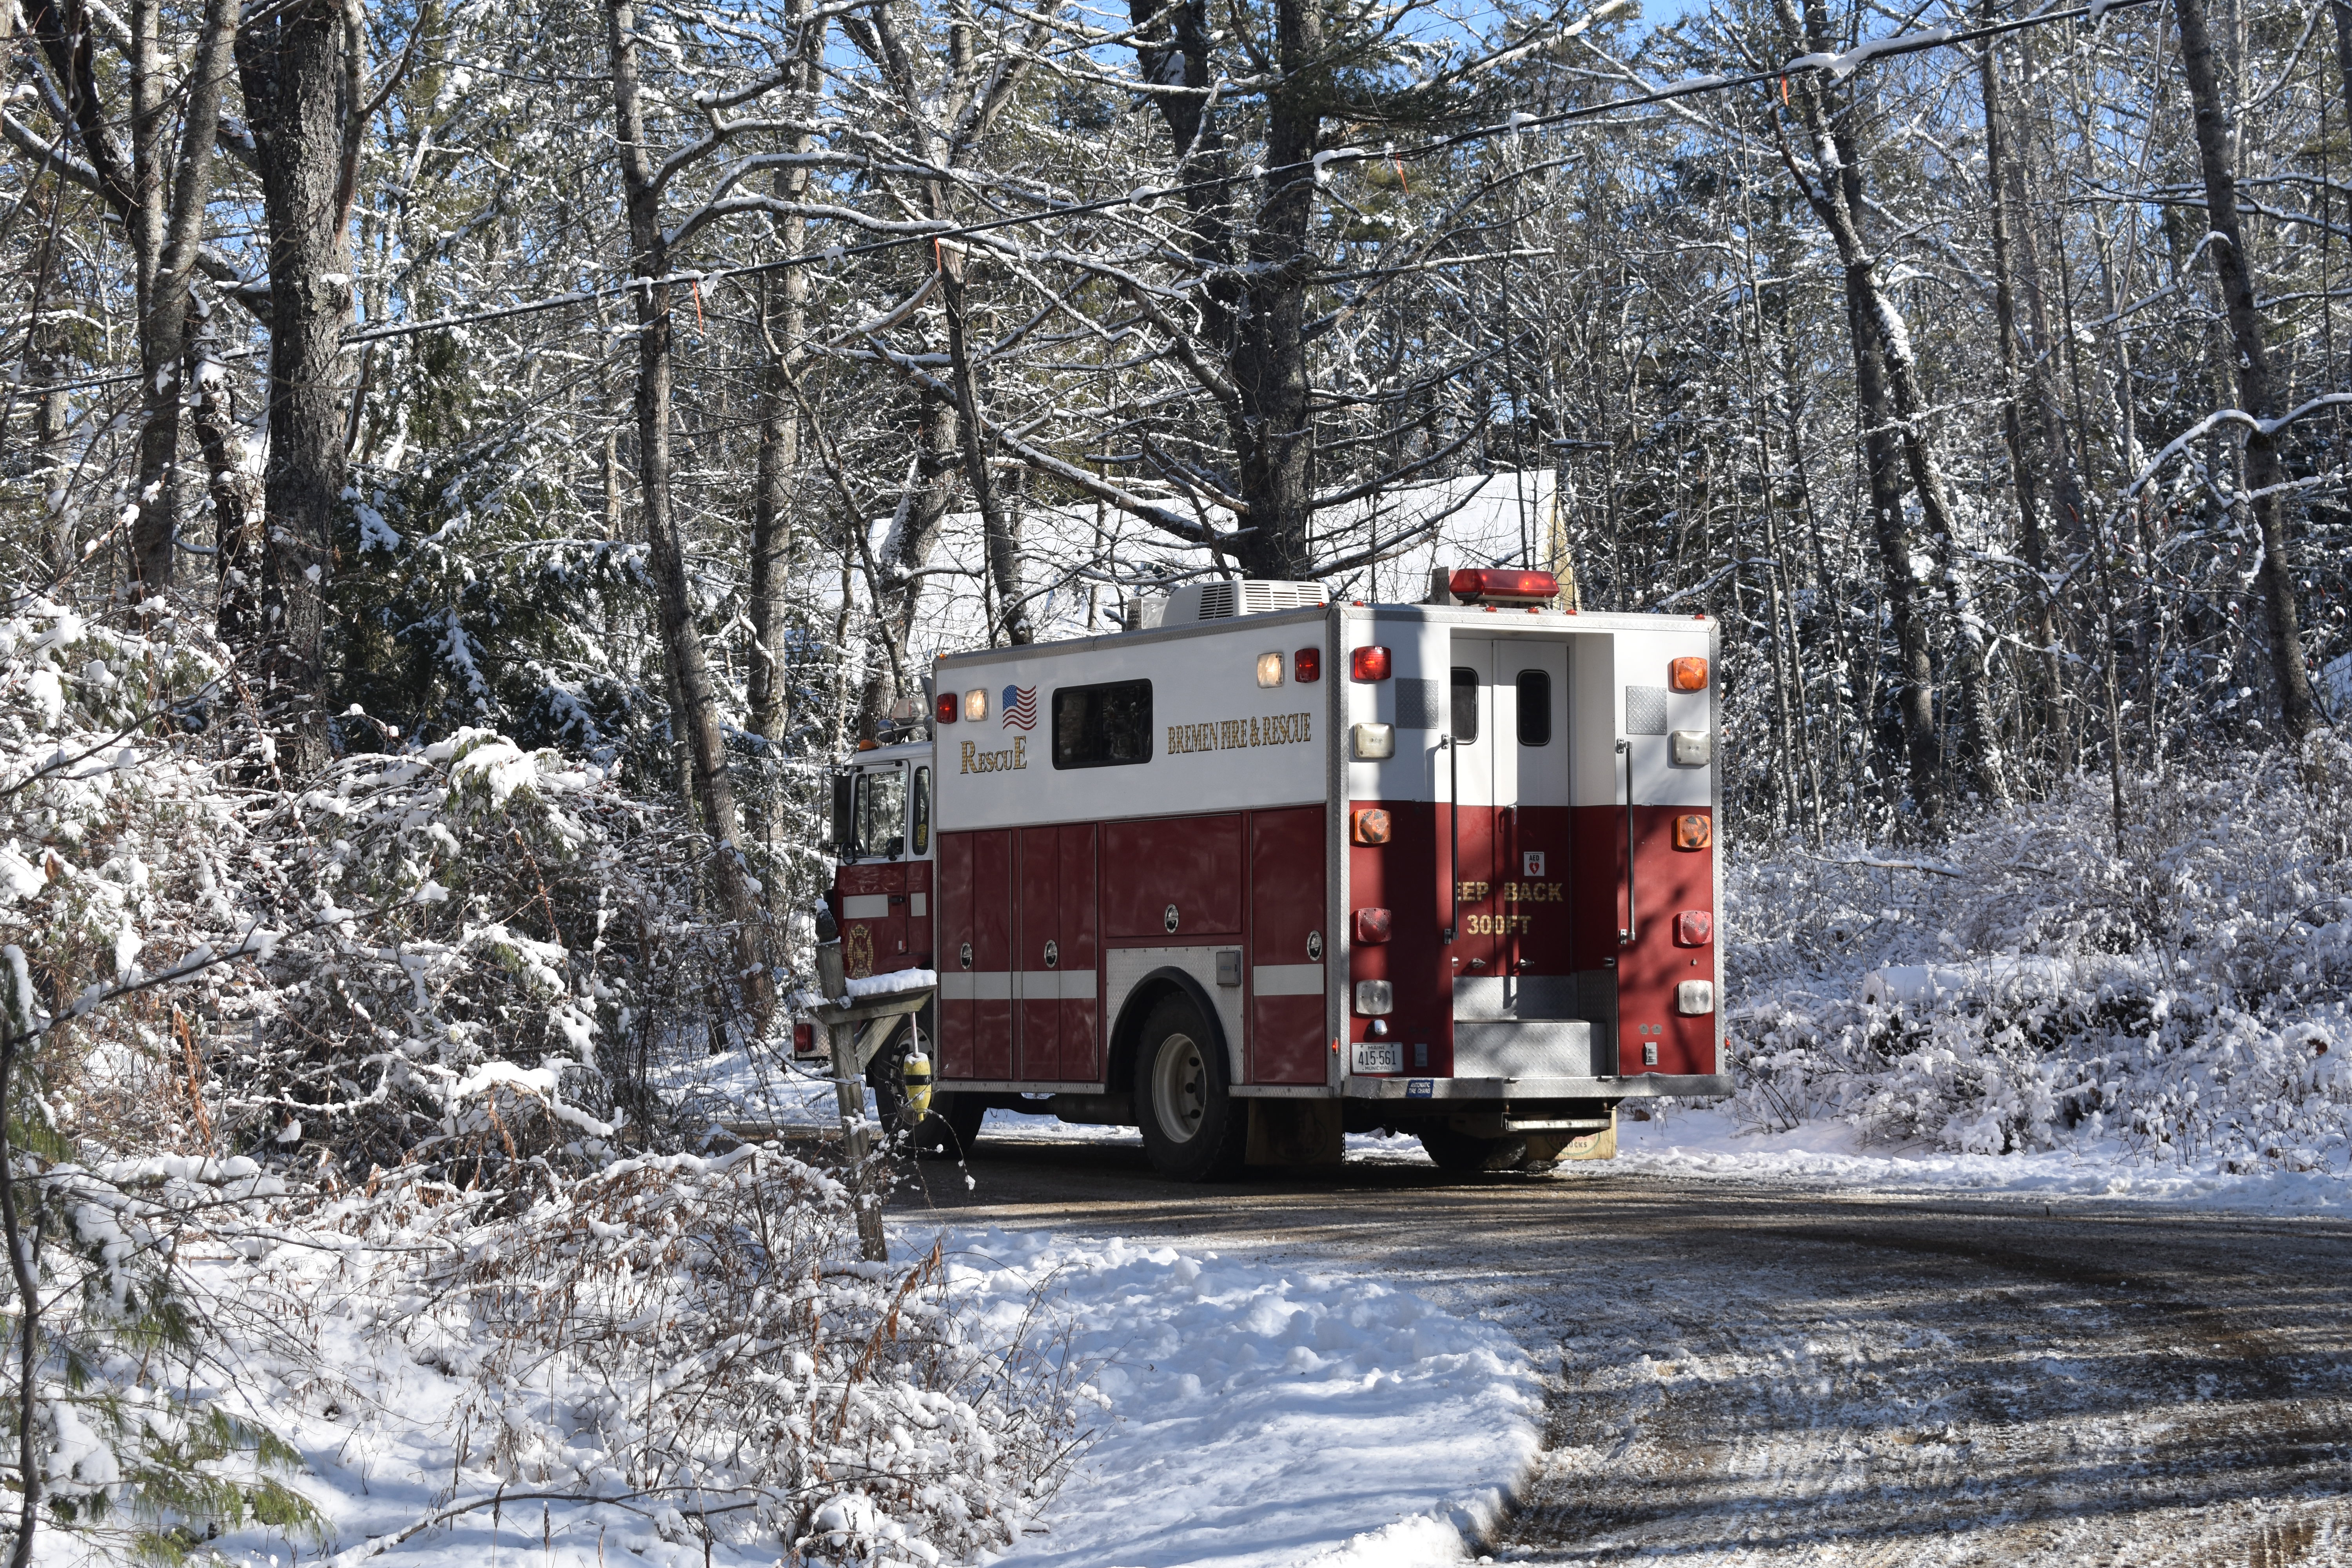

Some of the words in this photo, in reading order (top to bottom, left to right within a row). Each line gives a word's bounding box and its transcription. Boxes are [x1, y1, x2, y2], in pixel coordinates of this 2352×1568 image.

[1167, 722, 1218, 755] BREMEN
[1220, 719, 1247, 750] FIRE
[1249, 716, 1261, 747] &
[1262, 712, 1311, 746] RESCUE
[960, 735, 1027, 774] RESCUE
[1504, 882, 1563, 902] BACK
